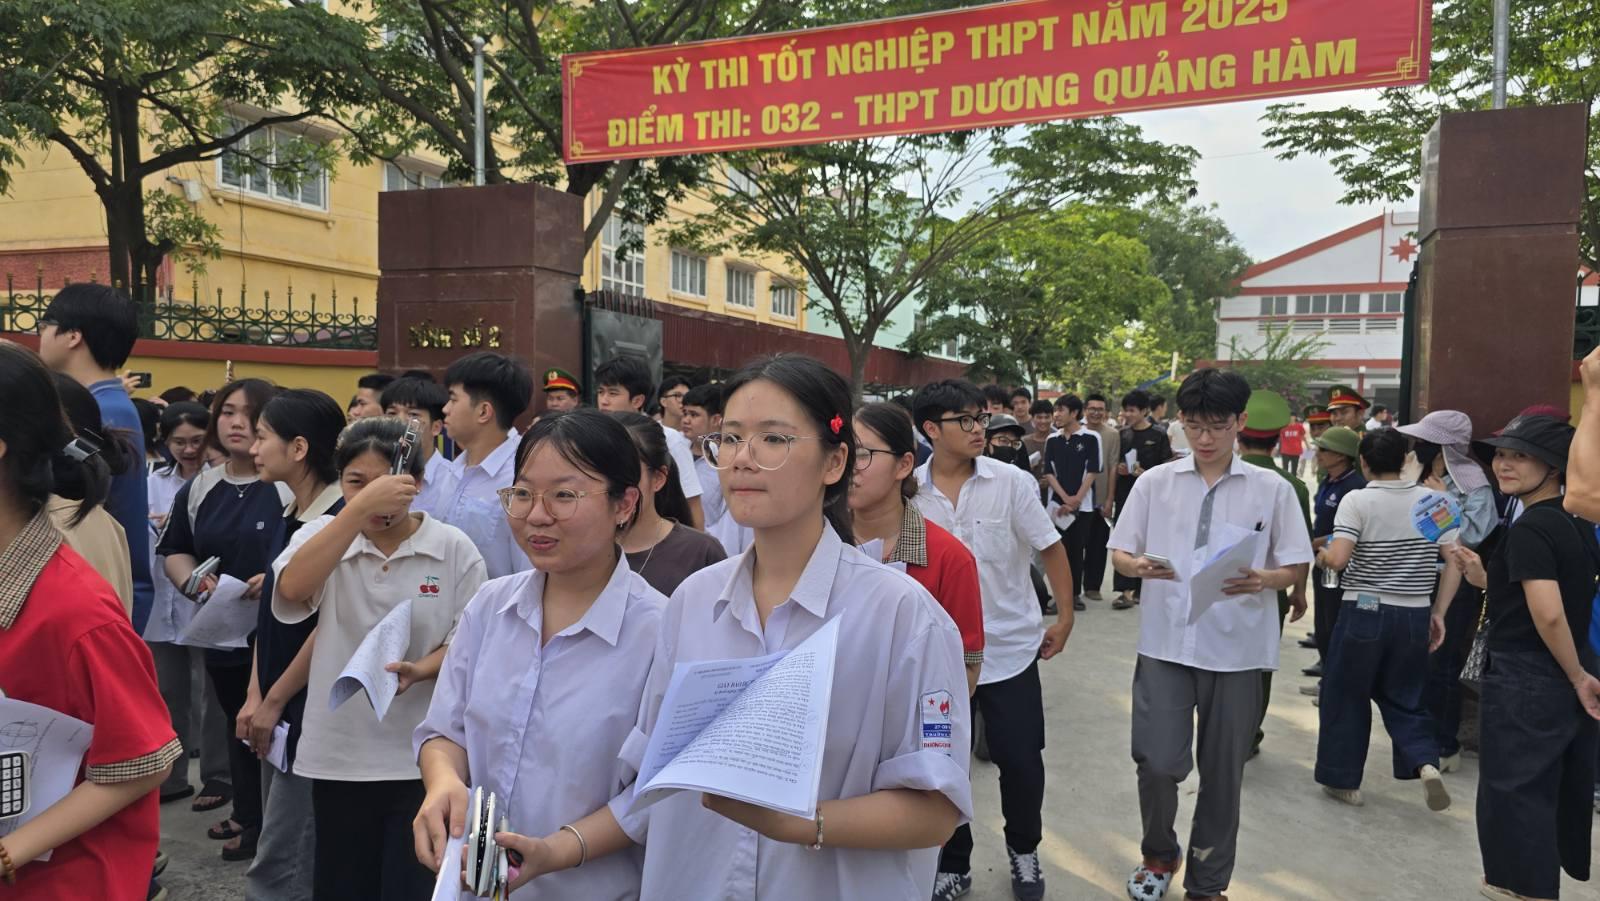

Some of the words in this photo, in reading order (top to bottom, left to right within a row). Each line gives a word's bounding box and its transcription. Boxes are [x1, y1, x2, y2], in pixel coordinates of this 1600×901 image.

[607, 104, 684, 147] ĐIỂM
[693, 108, 750, 141] THI:
[761, 101, 820, 136] 032
[831, 111, 844, 120] -
[854, 88, 939, 126] THPT
[950, 72, 1079, 117] DƯƠNG
[1093, 50, 1237, 105] QUẢNG
[1252, 37, 1357, 85] HÀM
[653, 58, 690, 95] KỲ
[701, 55, 749, 91] THI
[759, 38, 815, 83] TỐT
[827, 27, 954, 75] NGHIỆP
[966, 16, 1059, 60] THPT
[1072, 0, 1166, 47] NĂM
[1181, 0, 1289, 33] 2025
[487, 325, 501, 347] 2
